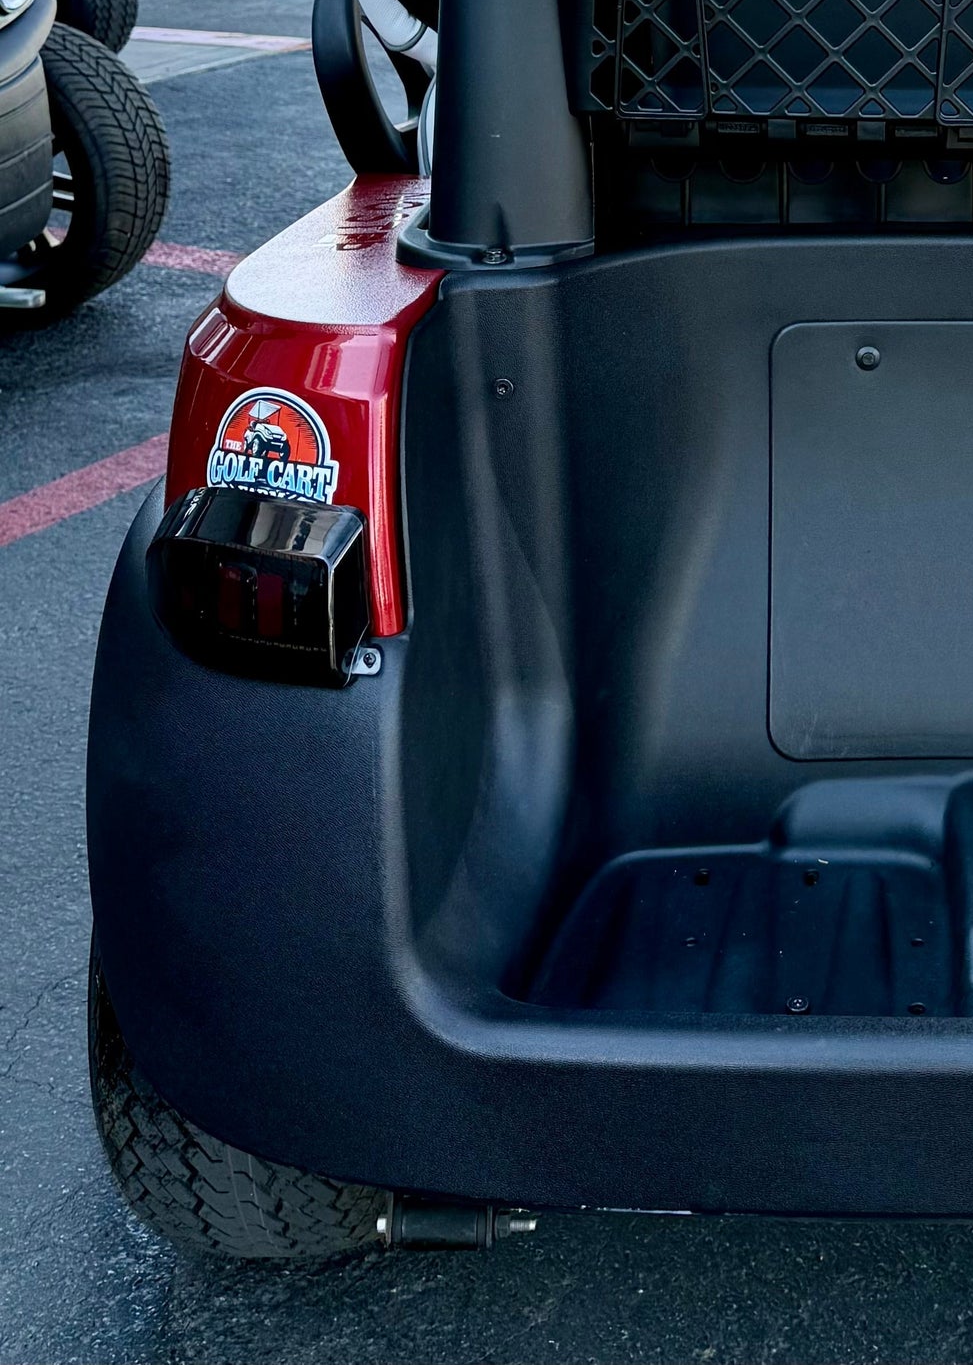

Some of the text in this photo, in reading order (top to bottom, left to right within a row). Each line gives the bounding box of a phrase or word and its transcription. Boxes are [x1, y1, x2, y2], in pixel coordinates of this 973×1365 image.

[224, 439, 242, 451] THE
[210, 450, 332, 502] GOLF CART
